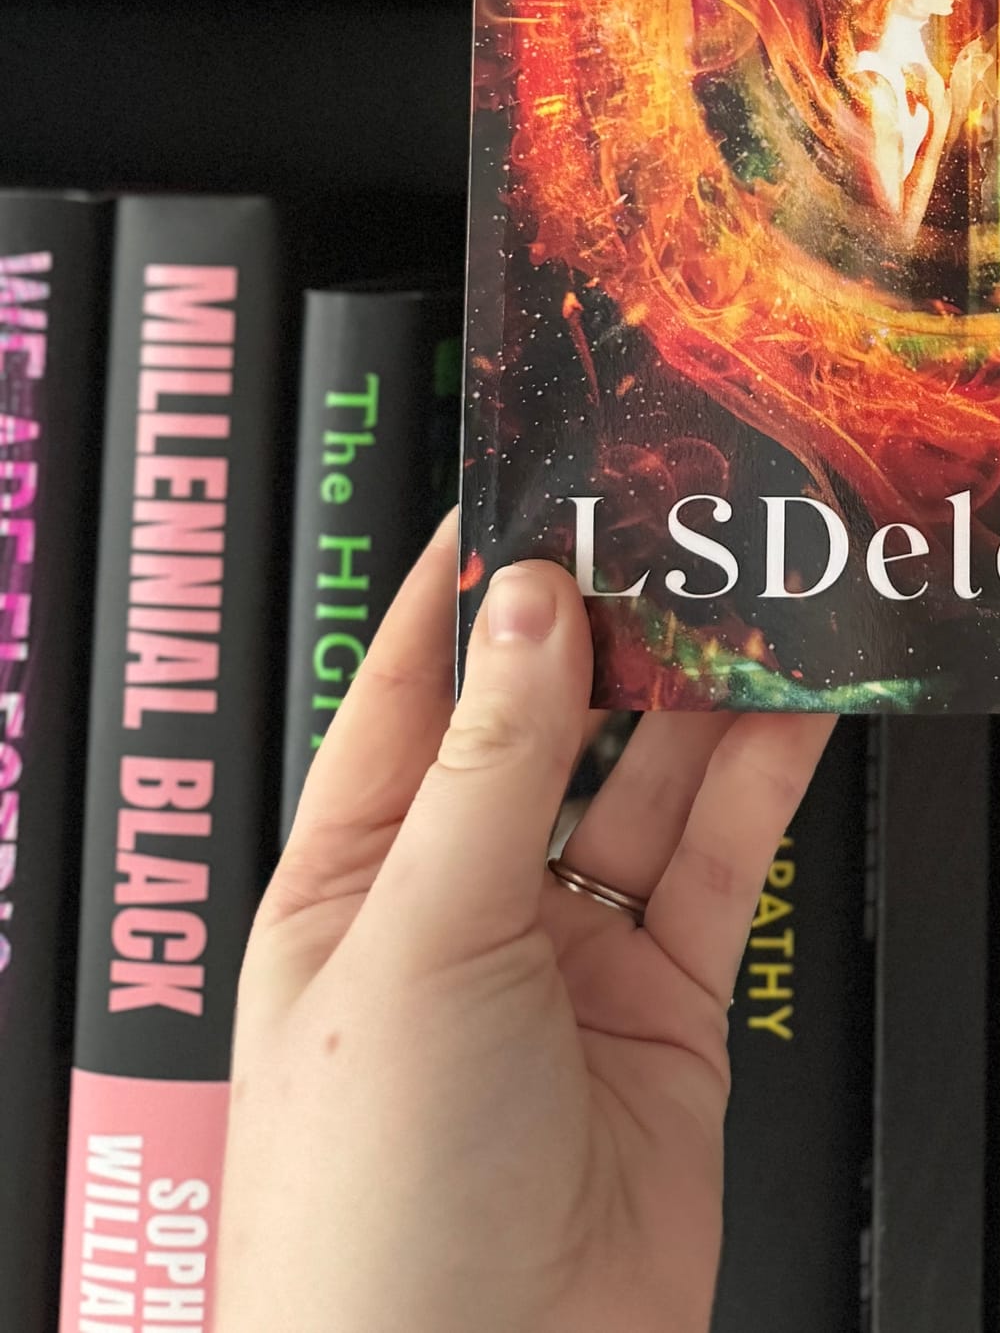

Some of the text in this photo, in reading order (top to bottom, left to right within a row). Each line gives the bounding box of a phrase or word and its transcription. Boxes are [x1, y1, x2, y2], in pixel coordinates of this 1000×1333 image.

[107, 264, 238, 1017] MILLENNIAL BLACK
[310, 373, 380, 748] The HIG
[748, 834, 795, 1040] PATHY
